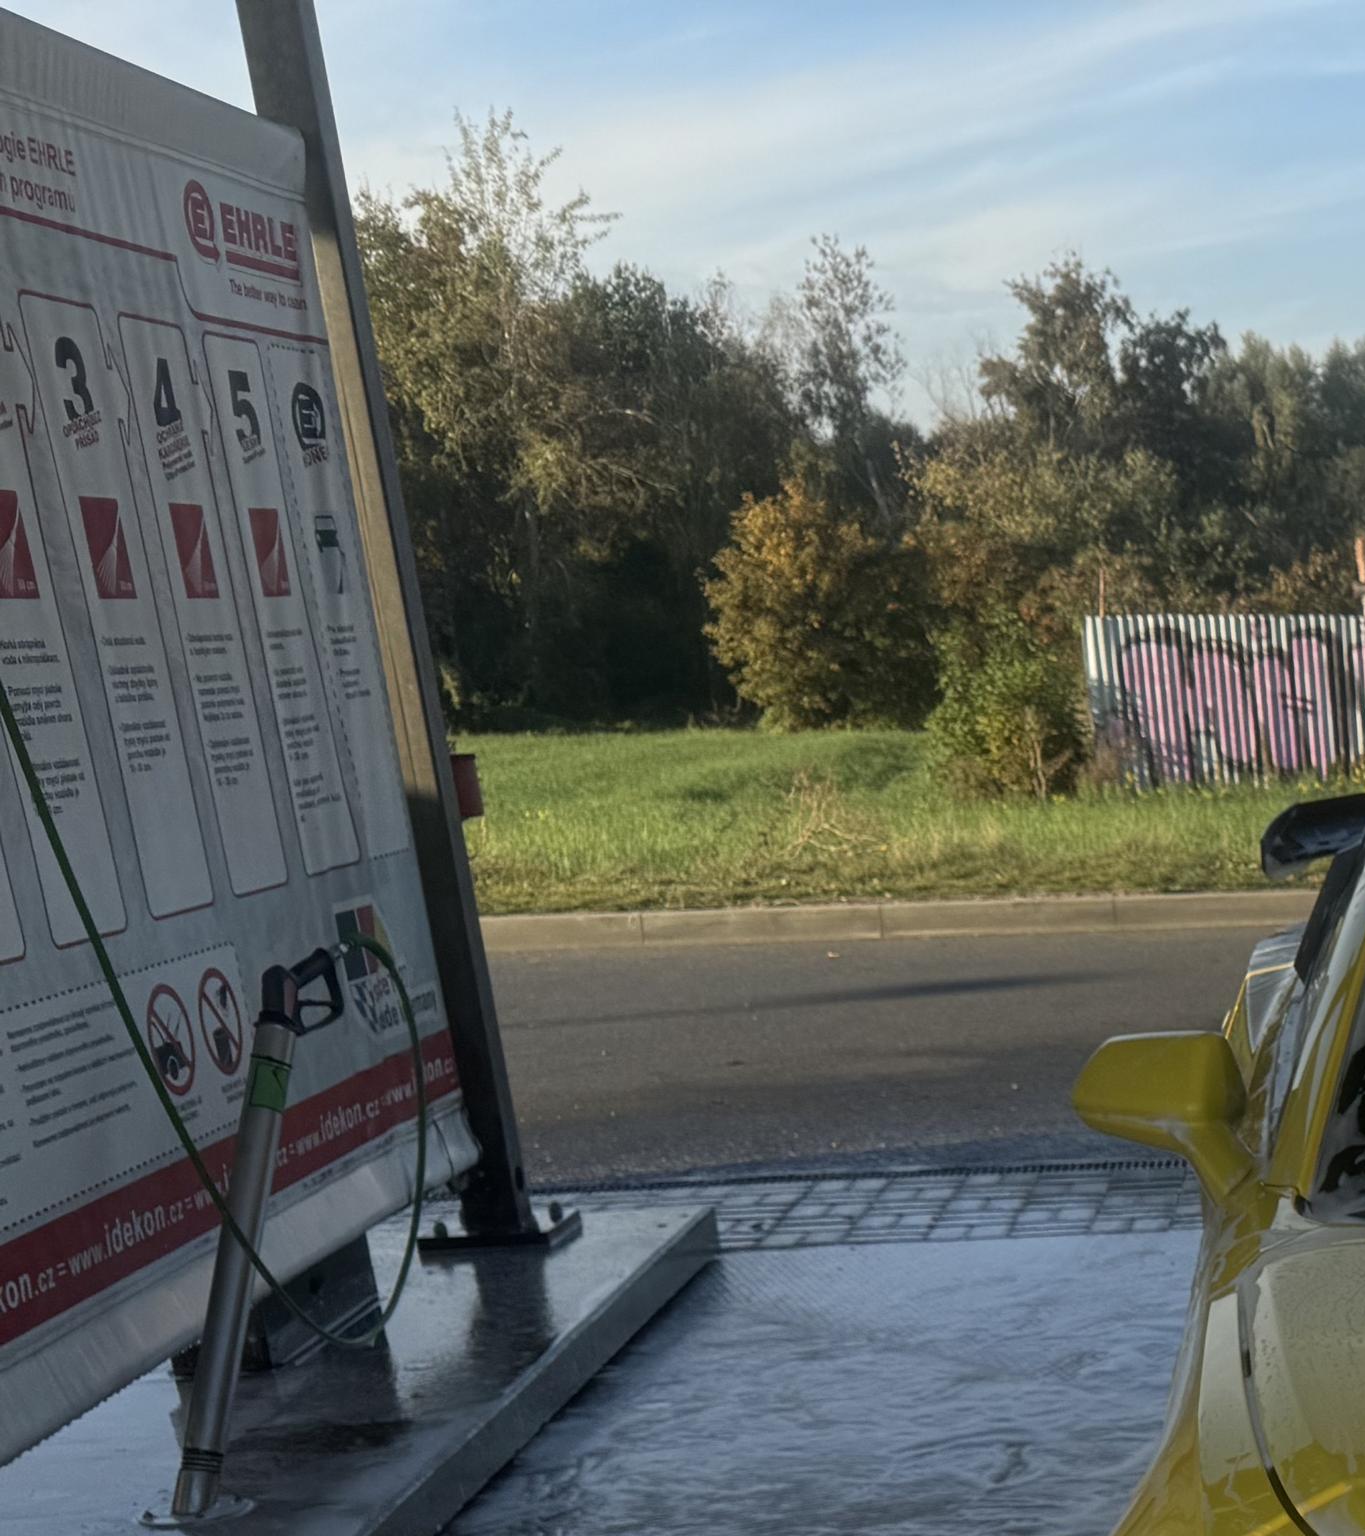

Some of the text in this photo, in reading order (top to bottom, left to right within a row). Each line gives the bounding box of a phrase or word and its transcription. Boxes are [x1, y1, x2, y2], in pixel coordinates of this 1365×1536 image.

[27, 136, 76, 177] EHRLE
[219, 201, 298, 262] EHRLE
[55, 336, 95, 421] 3
[154, 357, 183, 427] 4
[228, 370, 261, 448] 5
[67, 1200, 184, 1277] www.idekon.cz
[295, 1099, 380, 1156] www.idekon.cz
